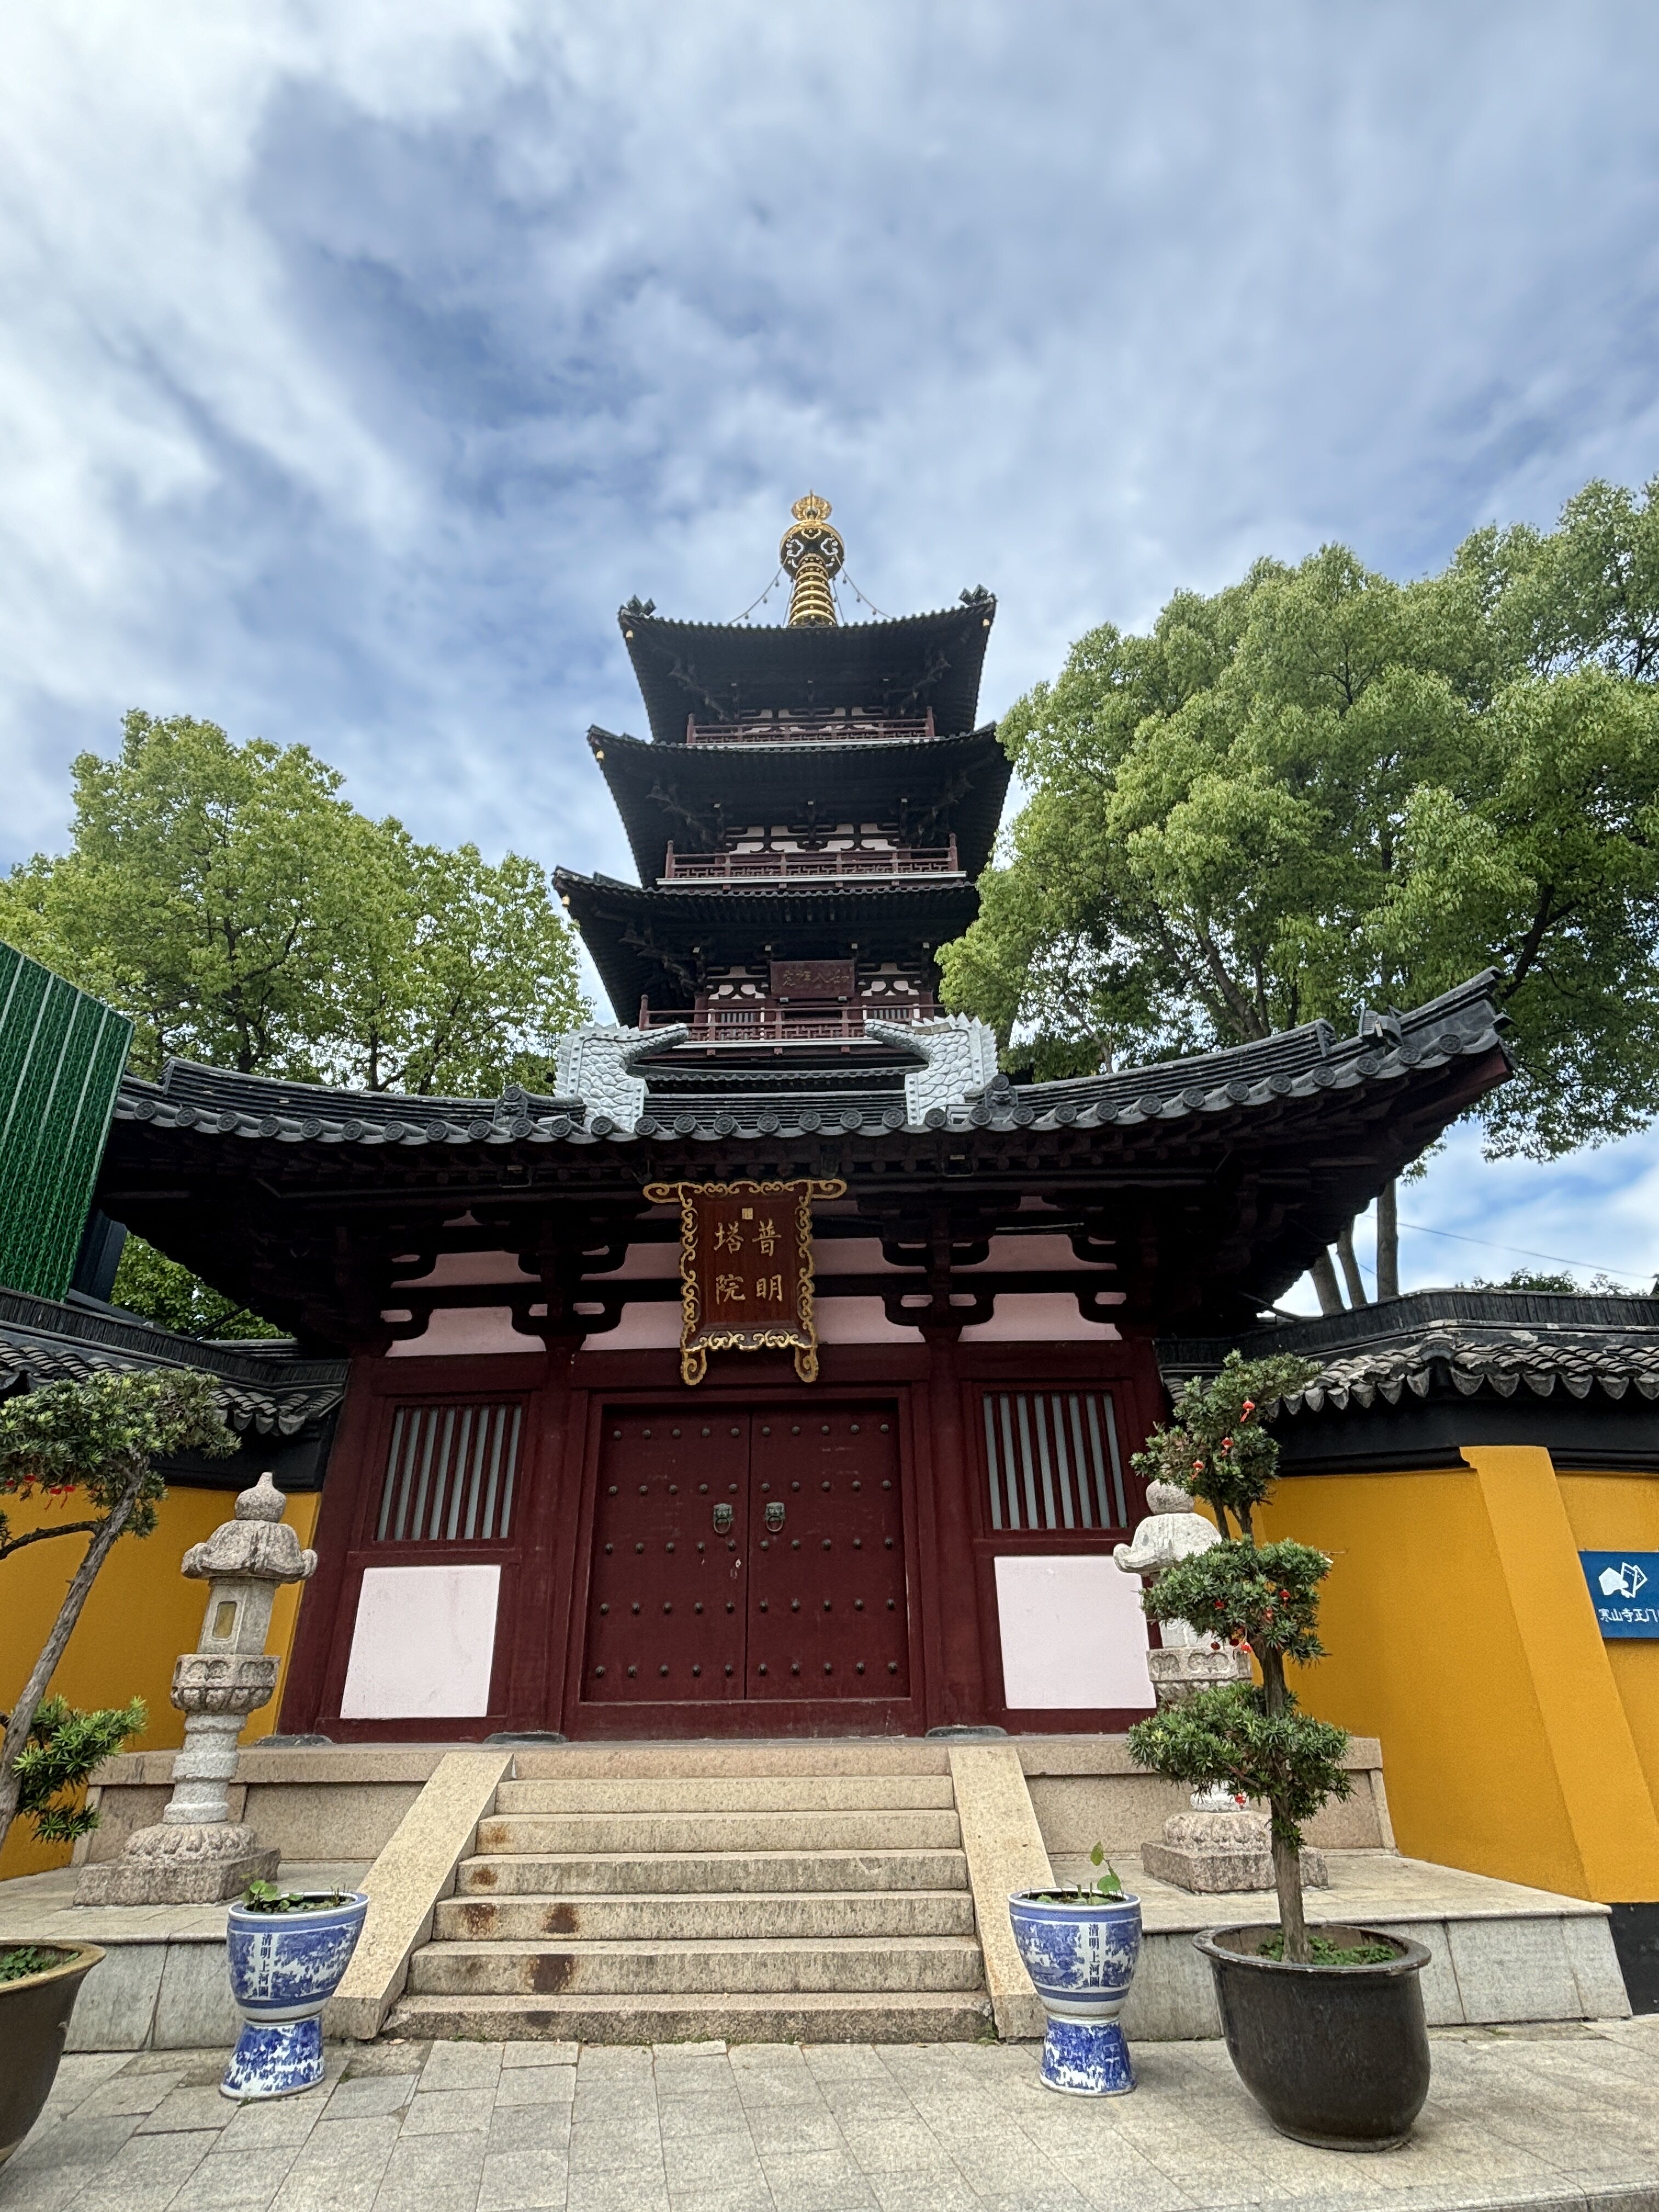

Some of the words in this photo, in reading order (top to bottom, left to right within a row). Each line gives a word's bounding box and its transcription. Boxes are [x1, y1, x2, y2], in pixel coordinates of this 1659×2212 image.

[713, 1221, 746, 1305] 塔院
[1598, 1607, 1659, 1623] 寒山寺正门
